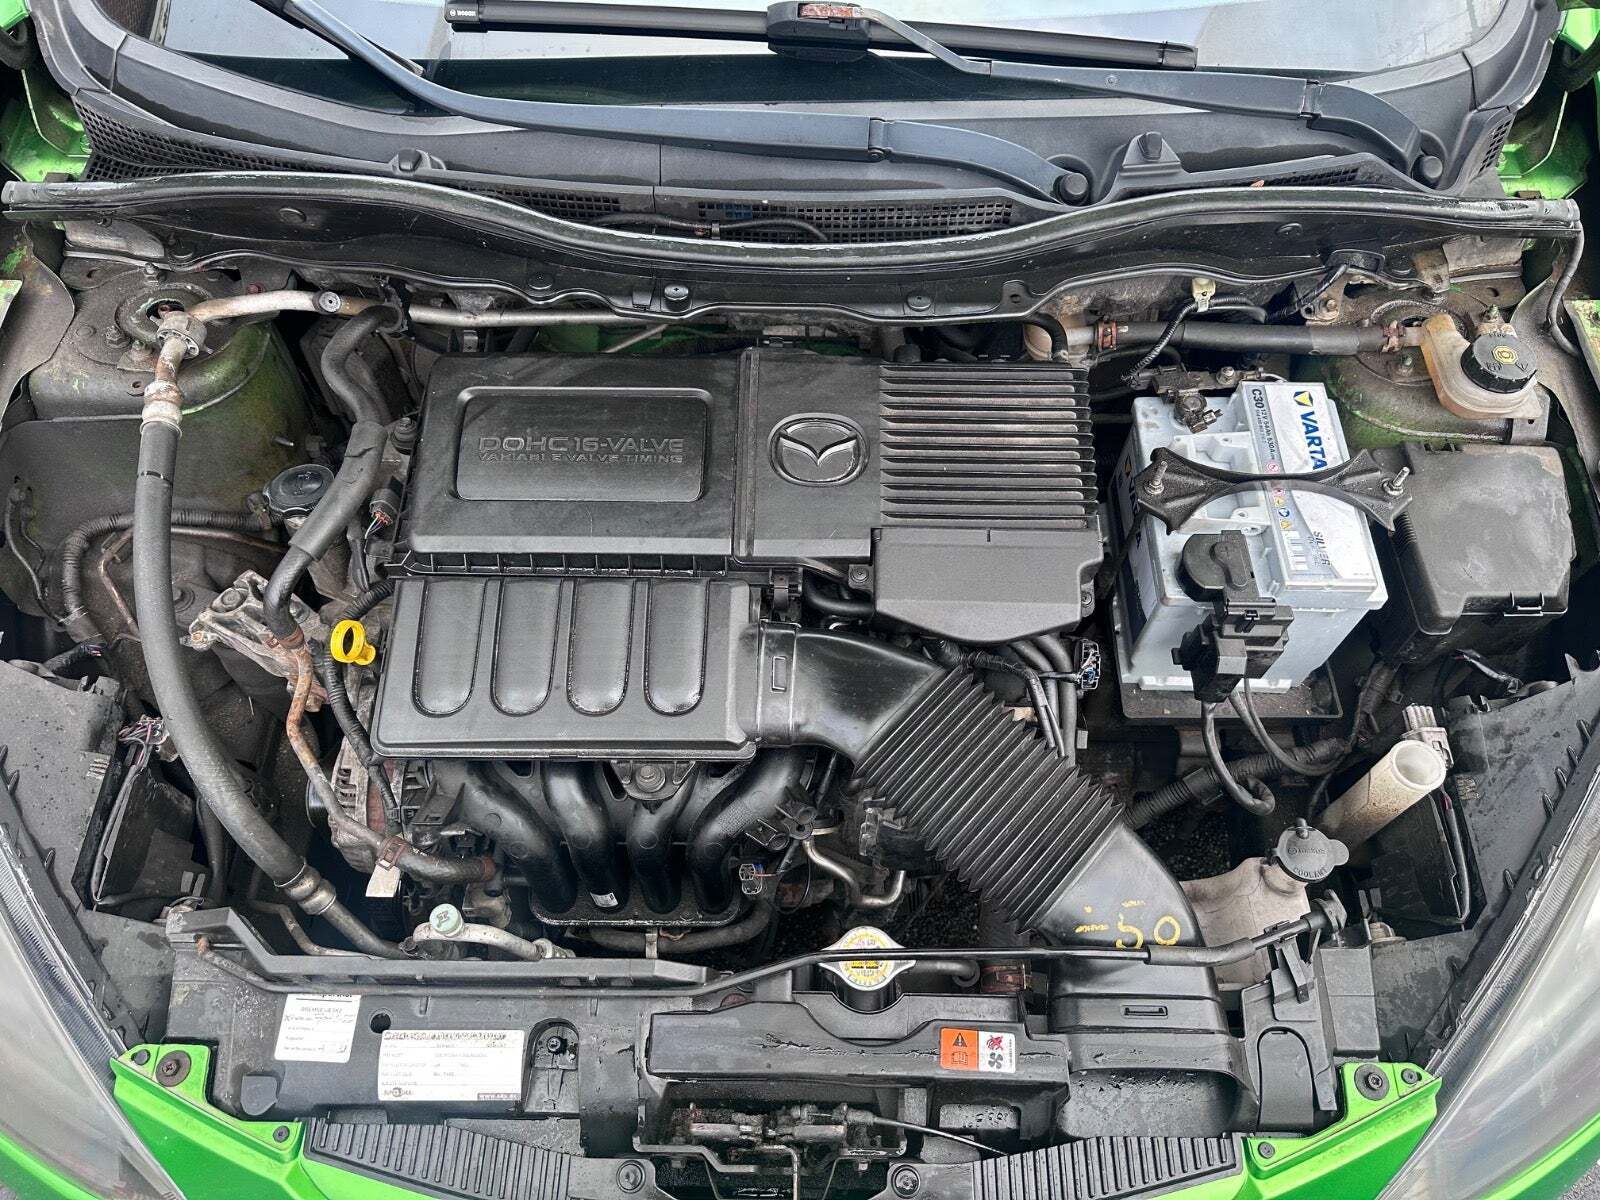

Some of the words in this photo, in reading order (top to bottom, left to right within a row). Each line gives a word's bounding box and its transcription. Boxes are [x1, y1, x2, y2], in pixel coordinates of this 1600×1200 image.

[1252, 388, 1265, 409] C30
[1260, 408, 1268, 420] 12V
[479, 437, 569, 452] DOHC
[574, 437, 684, 452] 16-VALVE
[1300, 411, 1328, 470] VARTA
